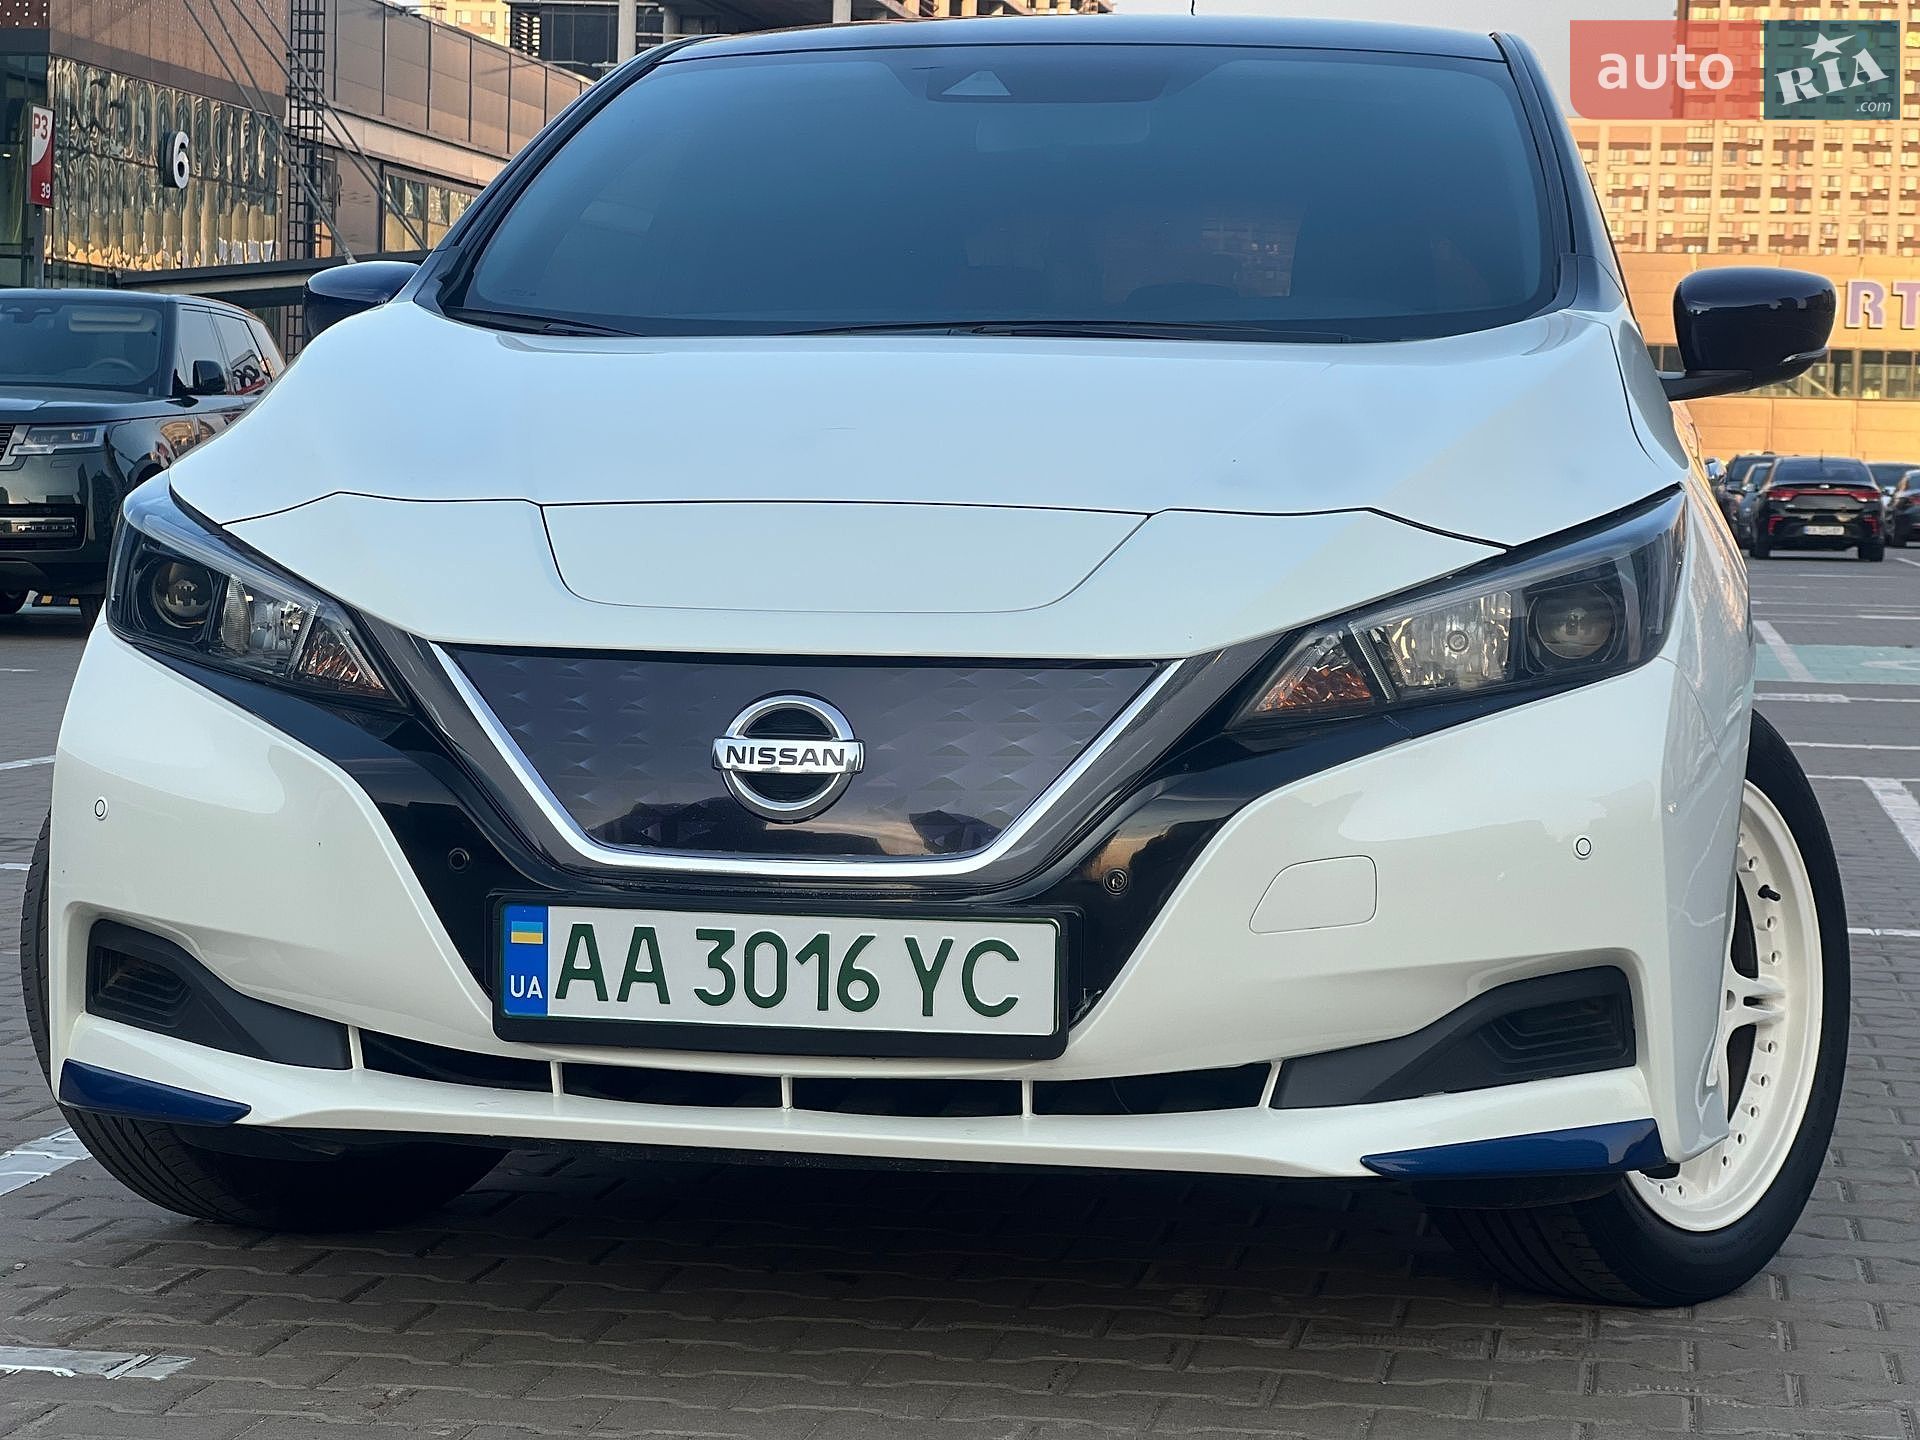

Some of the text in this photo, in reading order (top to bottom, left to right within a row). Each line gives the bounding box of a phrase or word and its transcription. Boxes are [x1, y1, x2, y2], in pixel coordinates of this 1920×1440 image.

[32, 112, 49, 141] P3
[172, 131, 190, 189] 6
[40, 181, 51, 200] 39
[725, 744, 846, 768] NISSAN
[555, 923, 1020, 1019] AA 3016 YC
[509, 974, 544, 1000] UA
